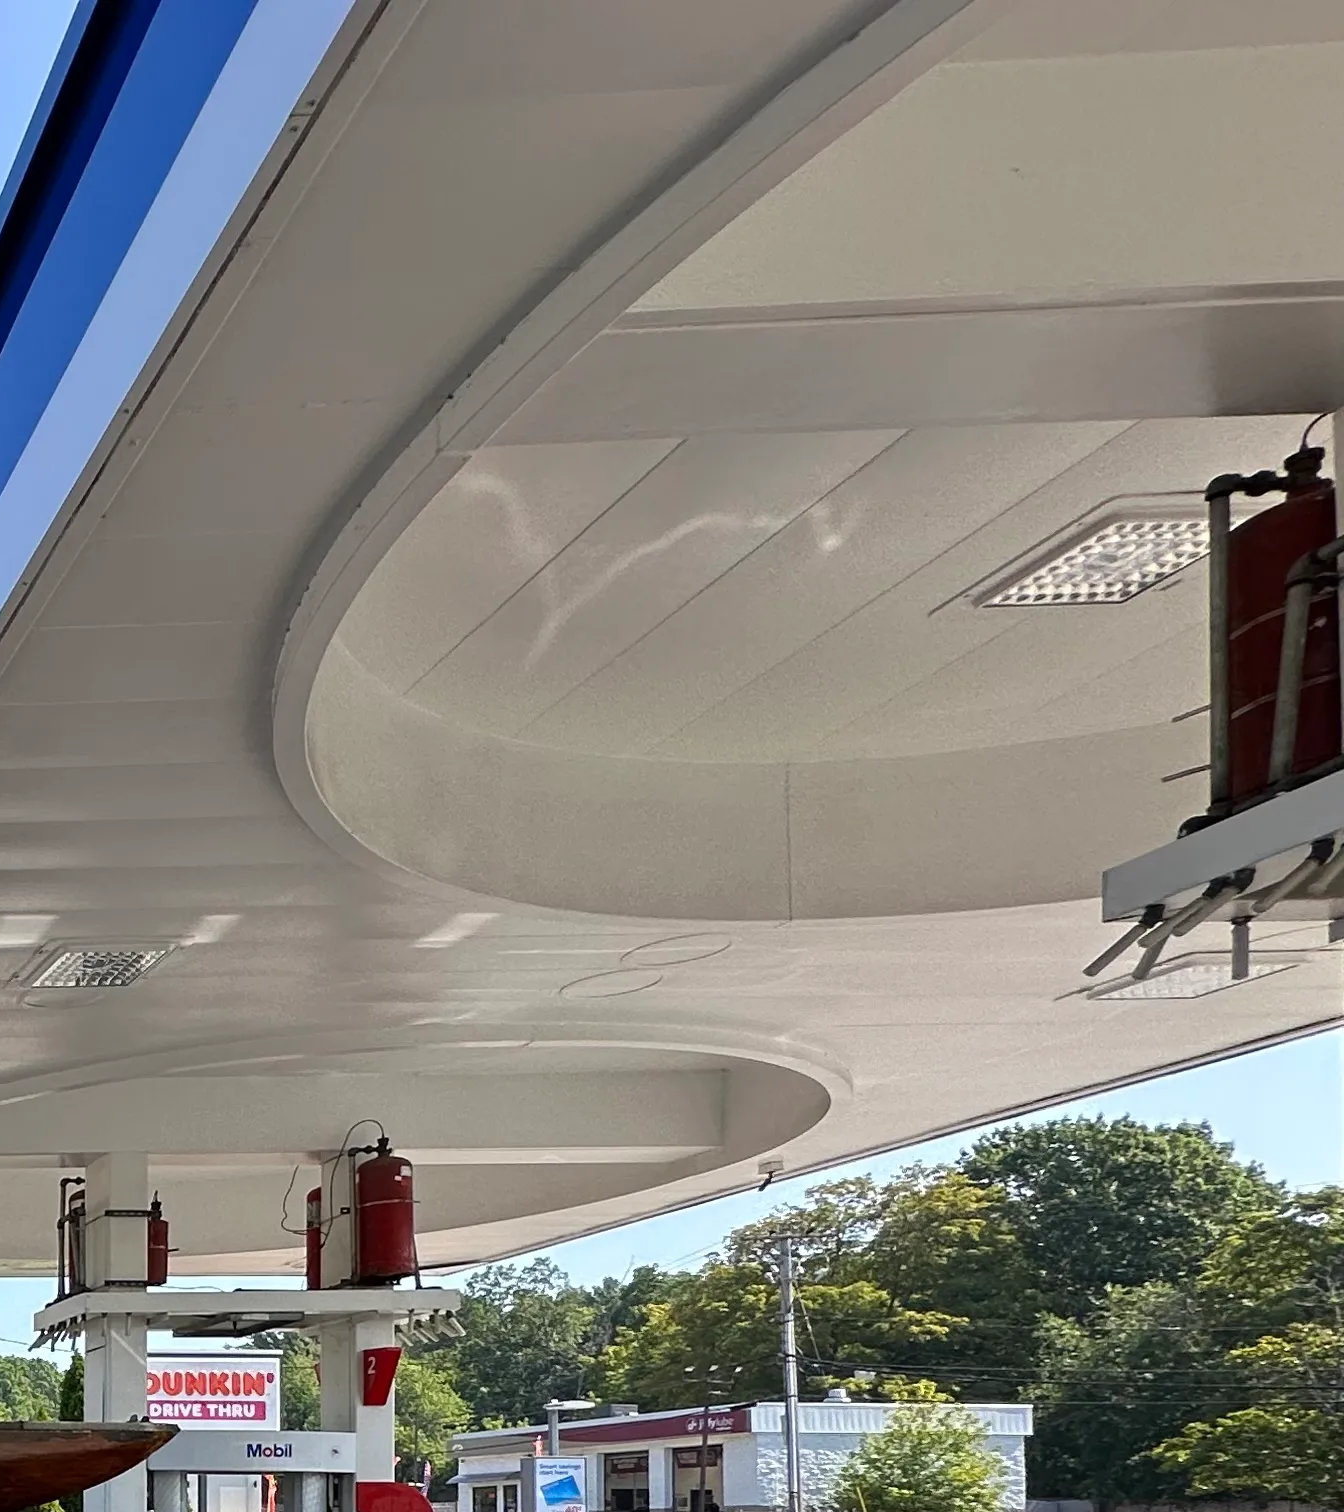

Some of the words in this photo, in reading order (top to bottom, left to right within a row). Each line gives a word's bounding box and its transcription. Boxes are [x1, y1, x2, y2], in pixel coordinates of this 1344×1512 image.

[367, 1356, 376, 1375] 2
[149, 1403, 203, 1418] DRIVE
[207, 1403, 256, 1418] THRU
[246, 1443, 293, 1458] Mobil
